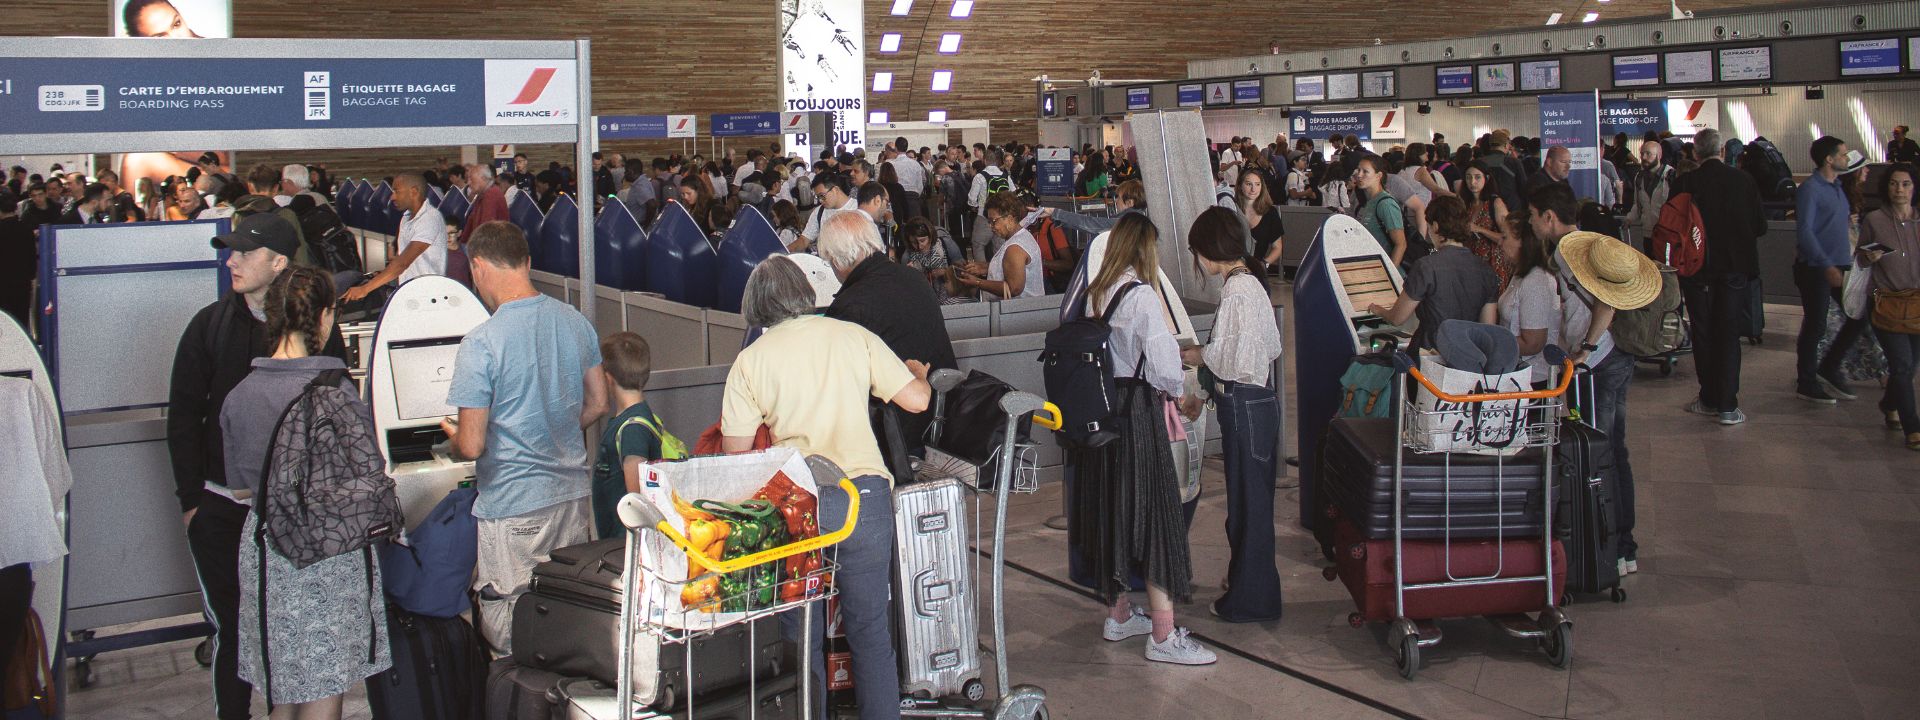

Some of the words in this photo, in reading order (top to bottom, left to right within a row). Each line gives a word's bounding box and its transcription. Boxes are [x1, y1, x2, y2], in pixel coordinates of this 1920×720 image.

[309, 75, 325, 83] AF
[119, 86, 163, 95] CARTE
[166, 85, 285, 95] D'EMBARQUEMENT
[342, 83, 404, 94] ÉTIQUETTE
[407, 84, 456, 93] BAGAGE
[119, 100, 189, 109] BOARDING
[193, 99, 225, 108] PASS
[342, 97, 400, 107] BAGGAGE
[404, 96, 427, 105] TAG
[788, 98, 861, 110] TOUJOURS
[1045, 98, 1052, 112] 4
[309, 108, 326, 117] JFK
[1543, 109, 1558, 117] Vols
[1610, 107, 1648, 116] BAGAGES
[1543, 118, 1582, 126] destination
[1618, 116, 1659, 125] DROP-OFF
[795, 131, 862, 146] RUE.
